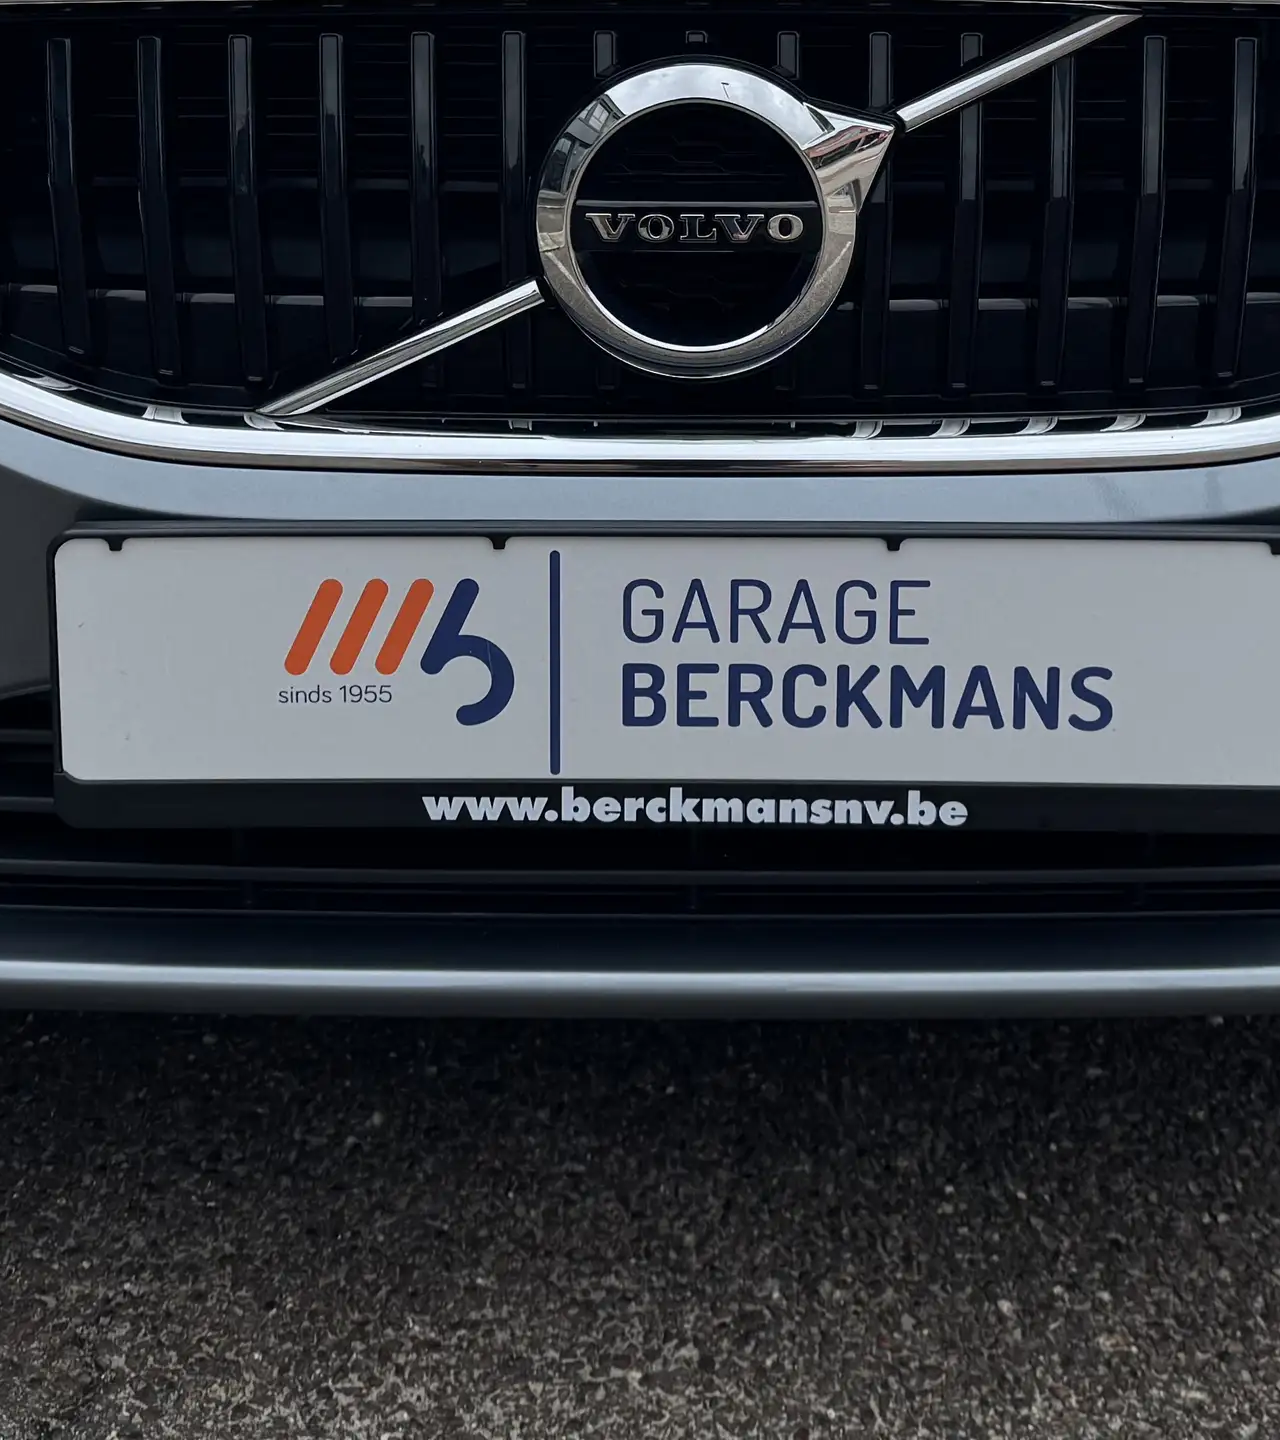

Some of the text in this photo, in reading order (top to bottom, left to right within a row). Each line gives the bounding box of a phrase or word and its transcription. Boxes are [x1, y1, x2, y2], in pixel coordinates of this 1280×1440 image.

[585, 213, 804, 243] VOLVO
[622, 578, 931, 646] GARAGE
[278, 684, 393, 704] sinds 1955
[621, 662, 1115, 732] BERCKMANS
[421, 787, 969, 827] www.berckmansnv.be
